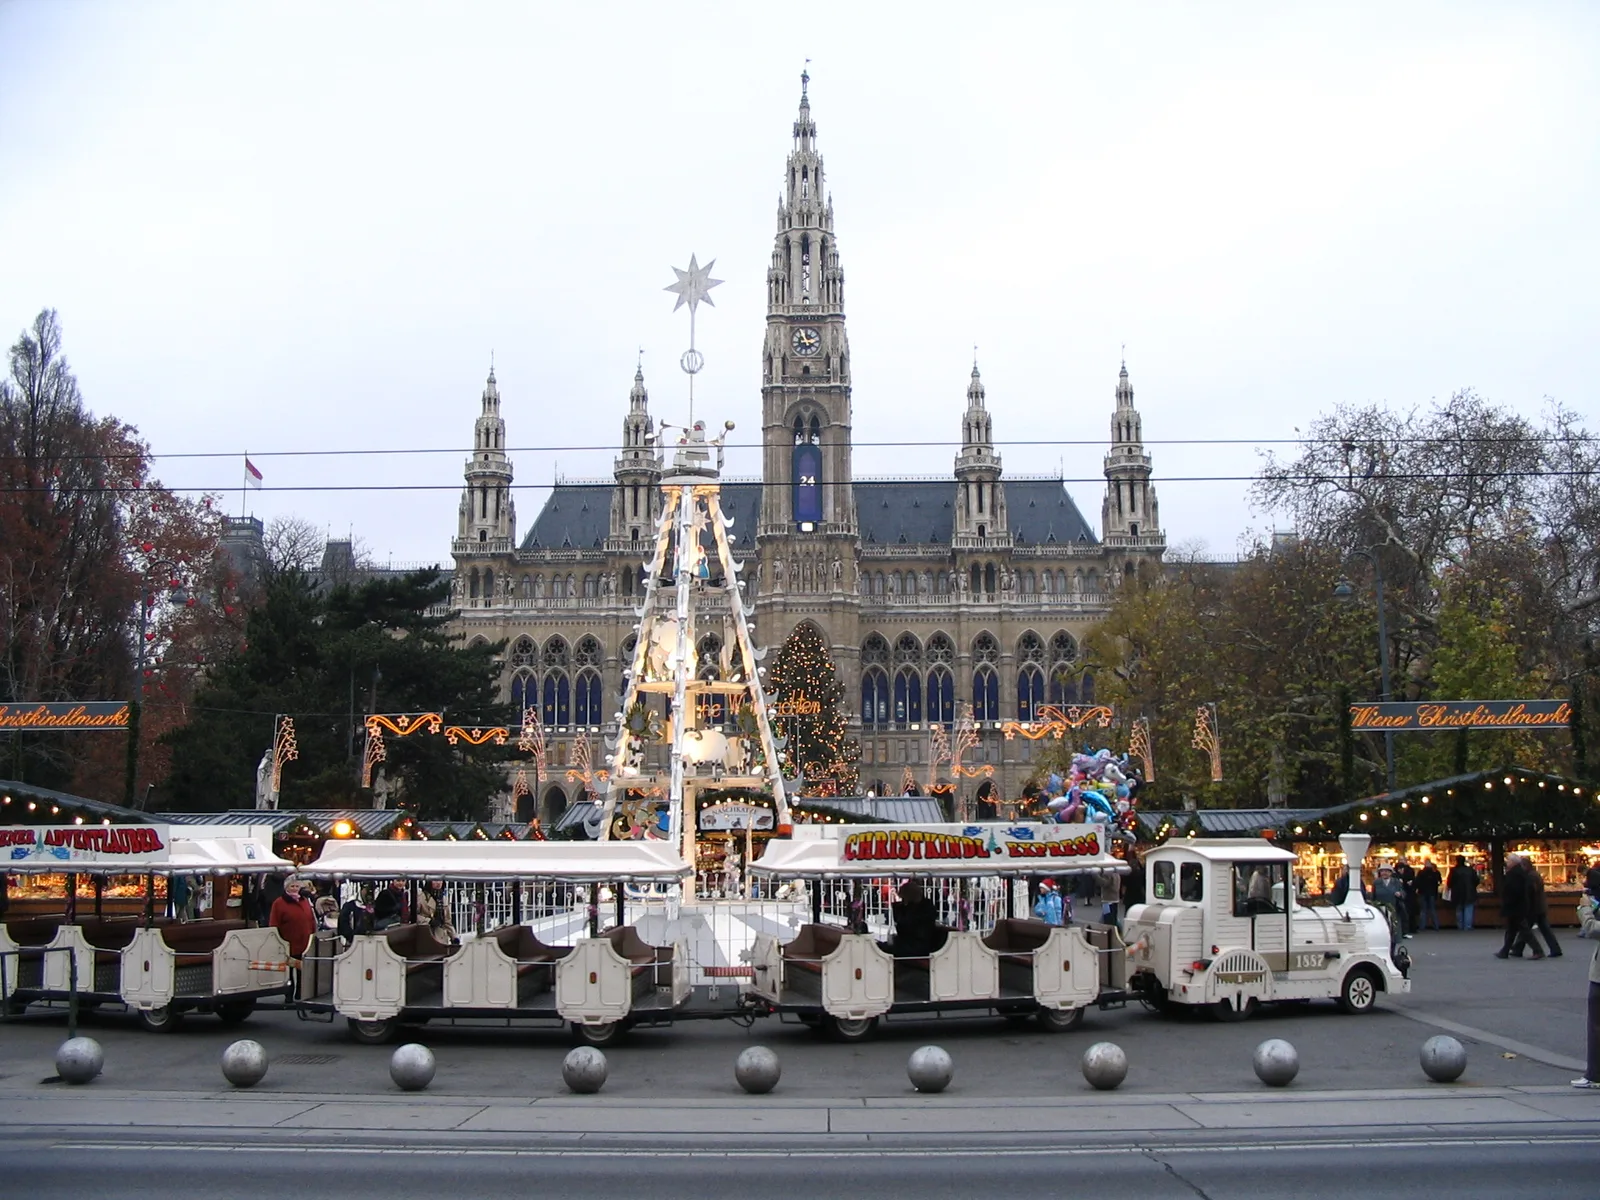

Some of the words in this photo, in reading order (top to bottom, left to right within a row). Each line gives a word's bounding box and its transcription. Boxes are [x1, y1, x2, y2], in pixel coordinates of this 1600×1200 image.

[799, 475, 816, 487] 24
[1350, 705, 1413, 727] Wiener
[1416, 702, 1573, 727] Christkindlmarkt
[44, 828, 164, 854] ADVENTZAUBER
[844, 830, 990, 861] CHRISTKINDL
[1006, 832, 1100, 858] EXPRESS
[1296, 954, 1325, 968] 1887
